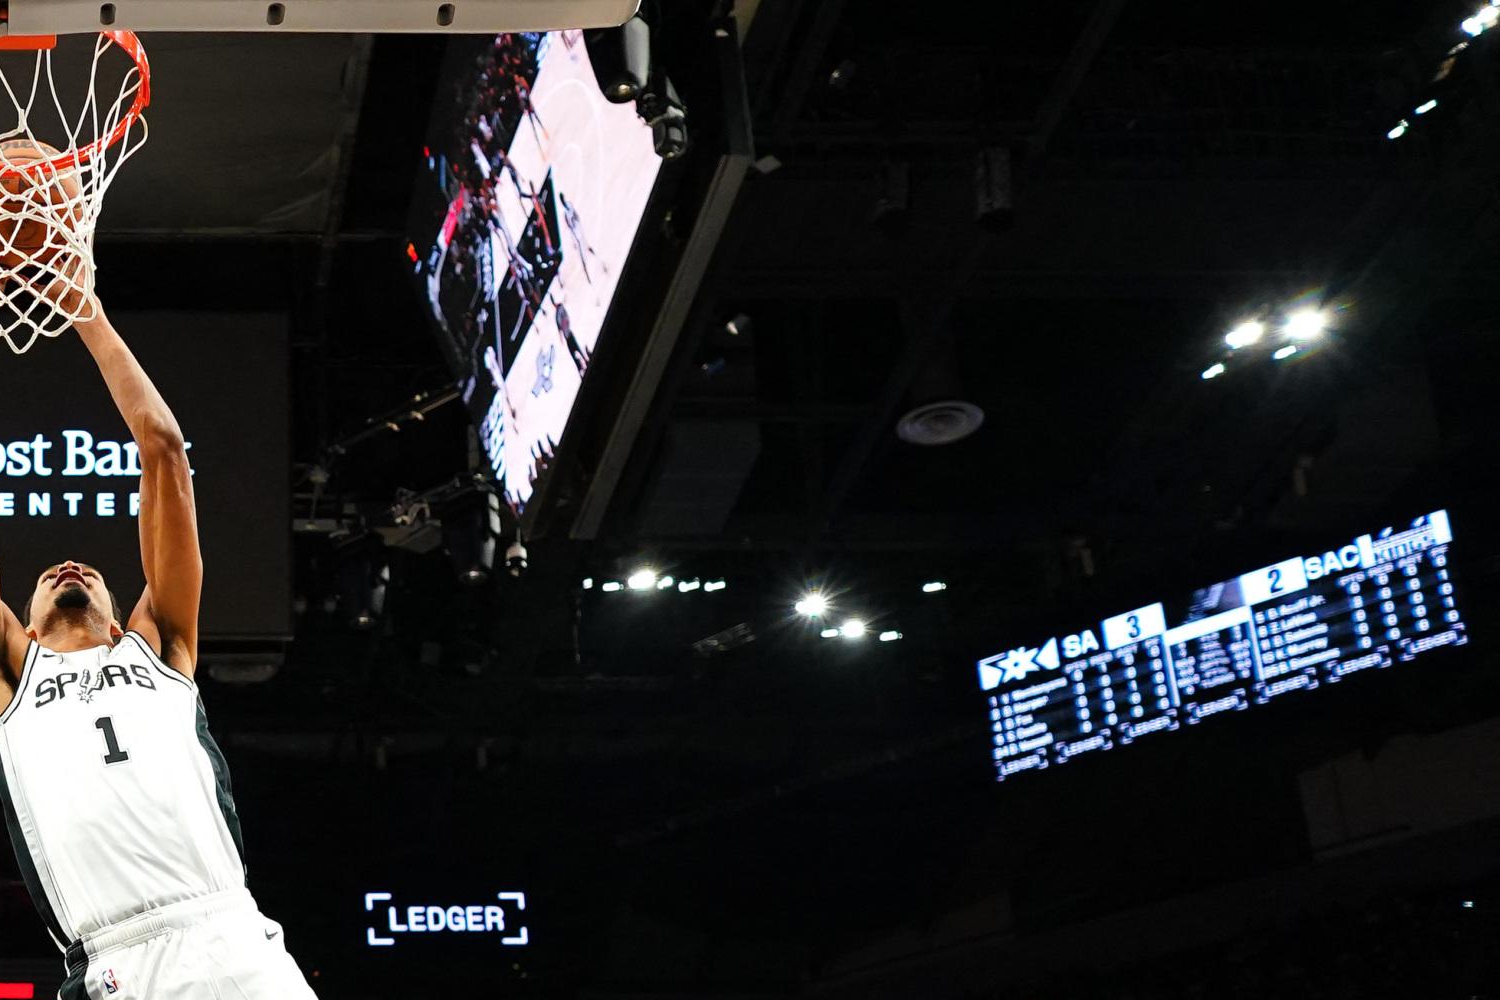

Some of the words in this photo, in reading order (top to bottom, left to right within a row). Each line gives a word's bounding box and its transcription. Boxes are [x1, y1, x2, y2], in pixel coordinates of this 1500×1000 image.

[1304, 545, 1361, 580] SAC
[1268, 568, 1284, 594] 2
[1126, 615, 1141, 638] 3
[1062, 629, 1099, 658] SA
[34, 664, 157, 708] SPURS
[94, 715, 129, 765] 1
[387, 905, 506, 932] LEDGER
